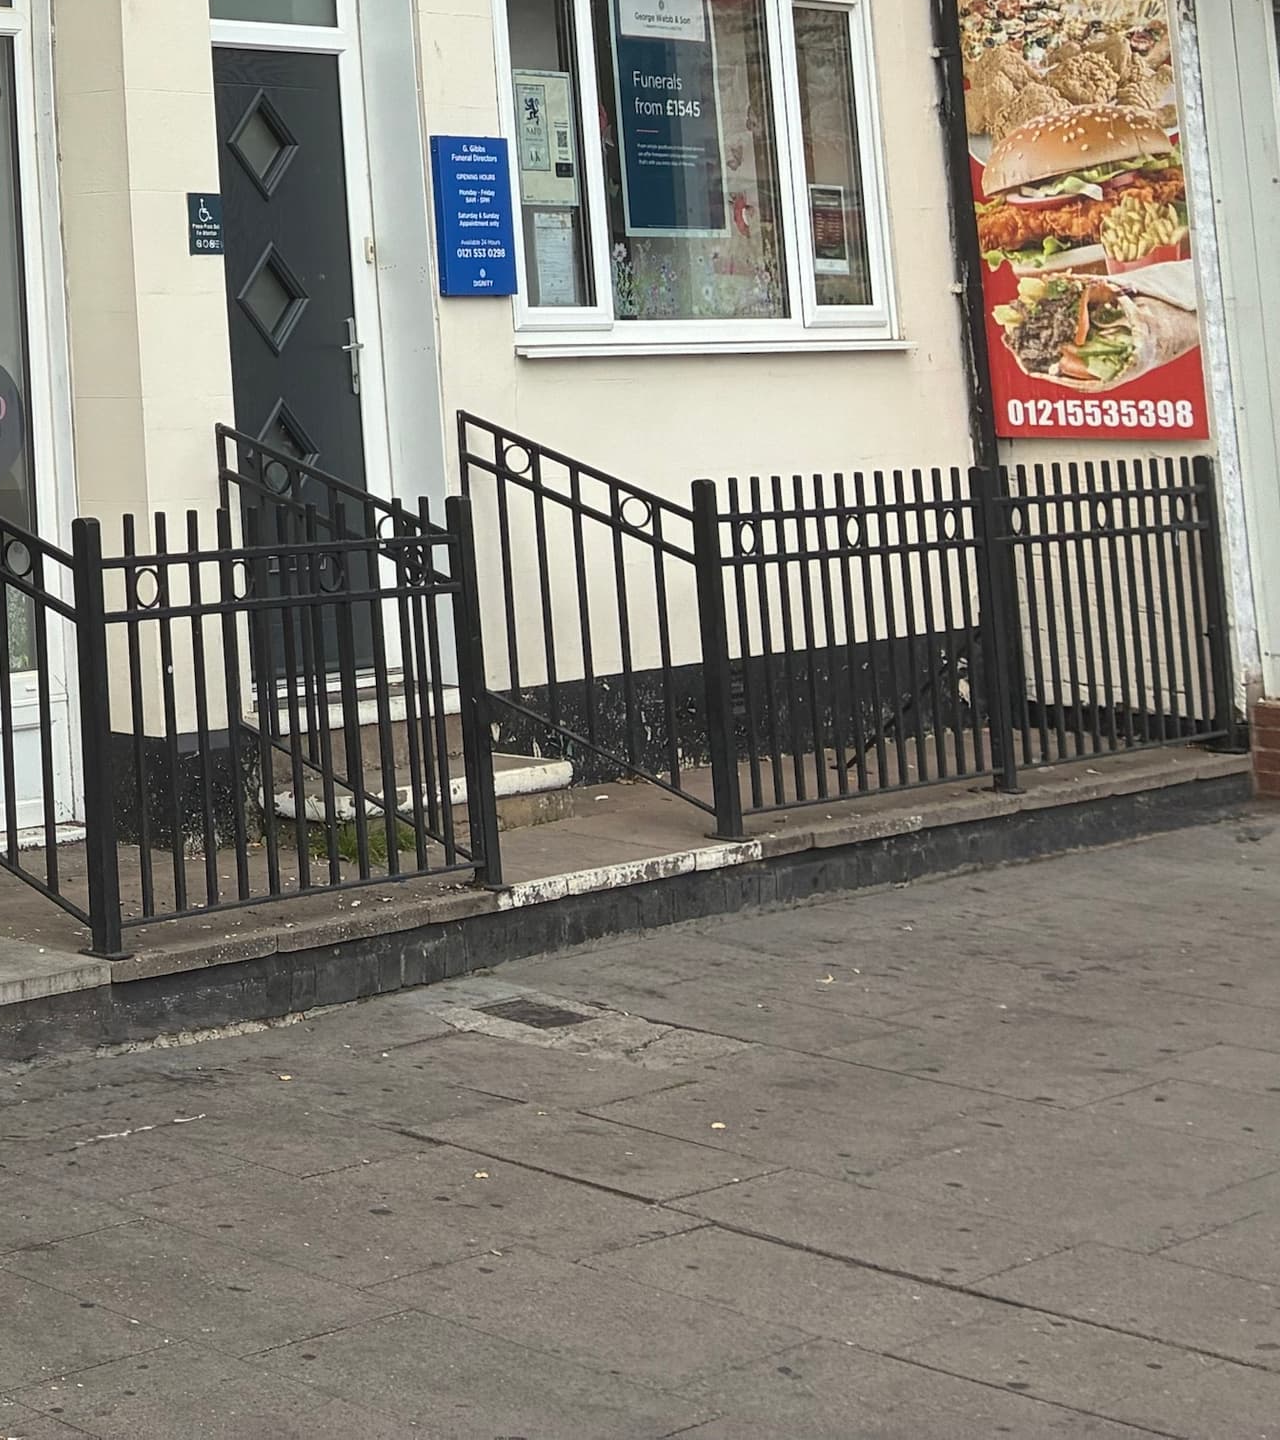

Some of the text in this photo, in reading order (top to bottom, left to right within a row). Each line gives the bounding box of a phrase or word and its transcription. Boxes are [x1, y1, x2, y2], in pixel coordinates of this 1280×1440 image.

[634, 12, 655, 23] George
[633, 70, 682, 91] Funerals
[634, 97, 701, 118] from £1545
[451, 153, 497, 163] Funeral Directors
[457, 248, 506, 258] 0121 553 0298
[1007, 398, 1193, 428] 01215535398
